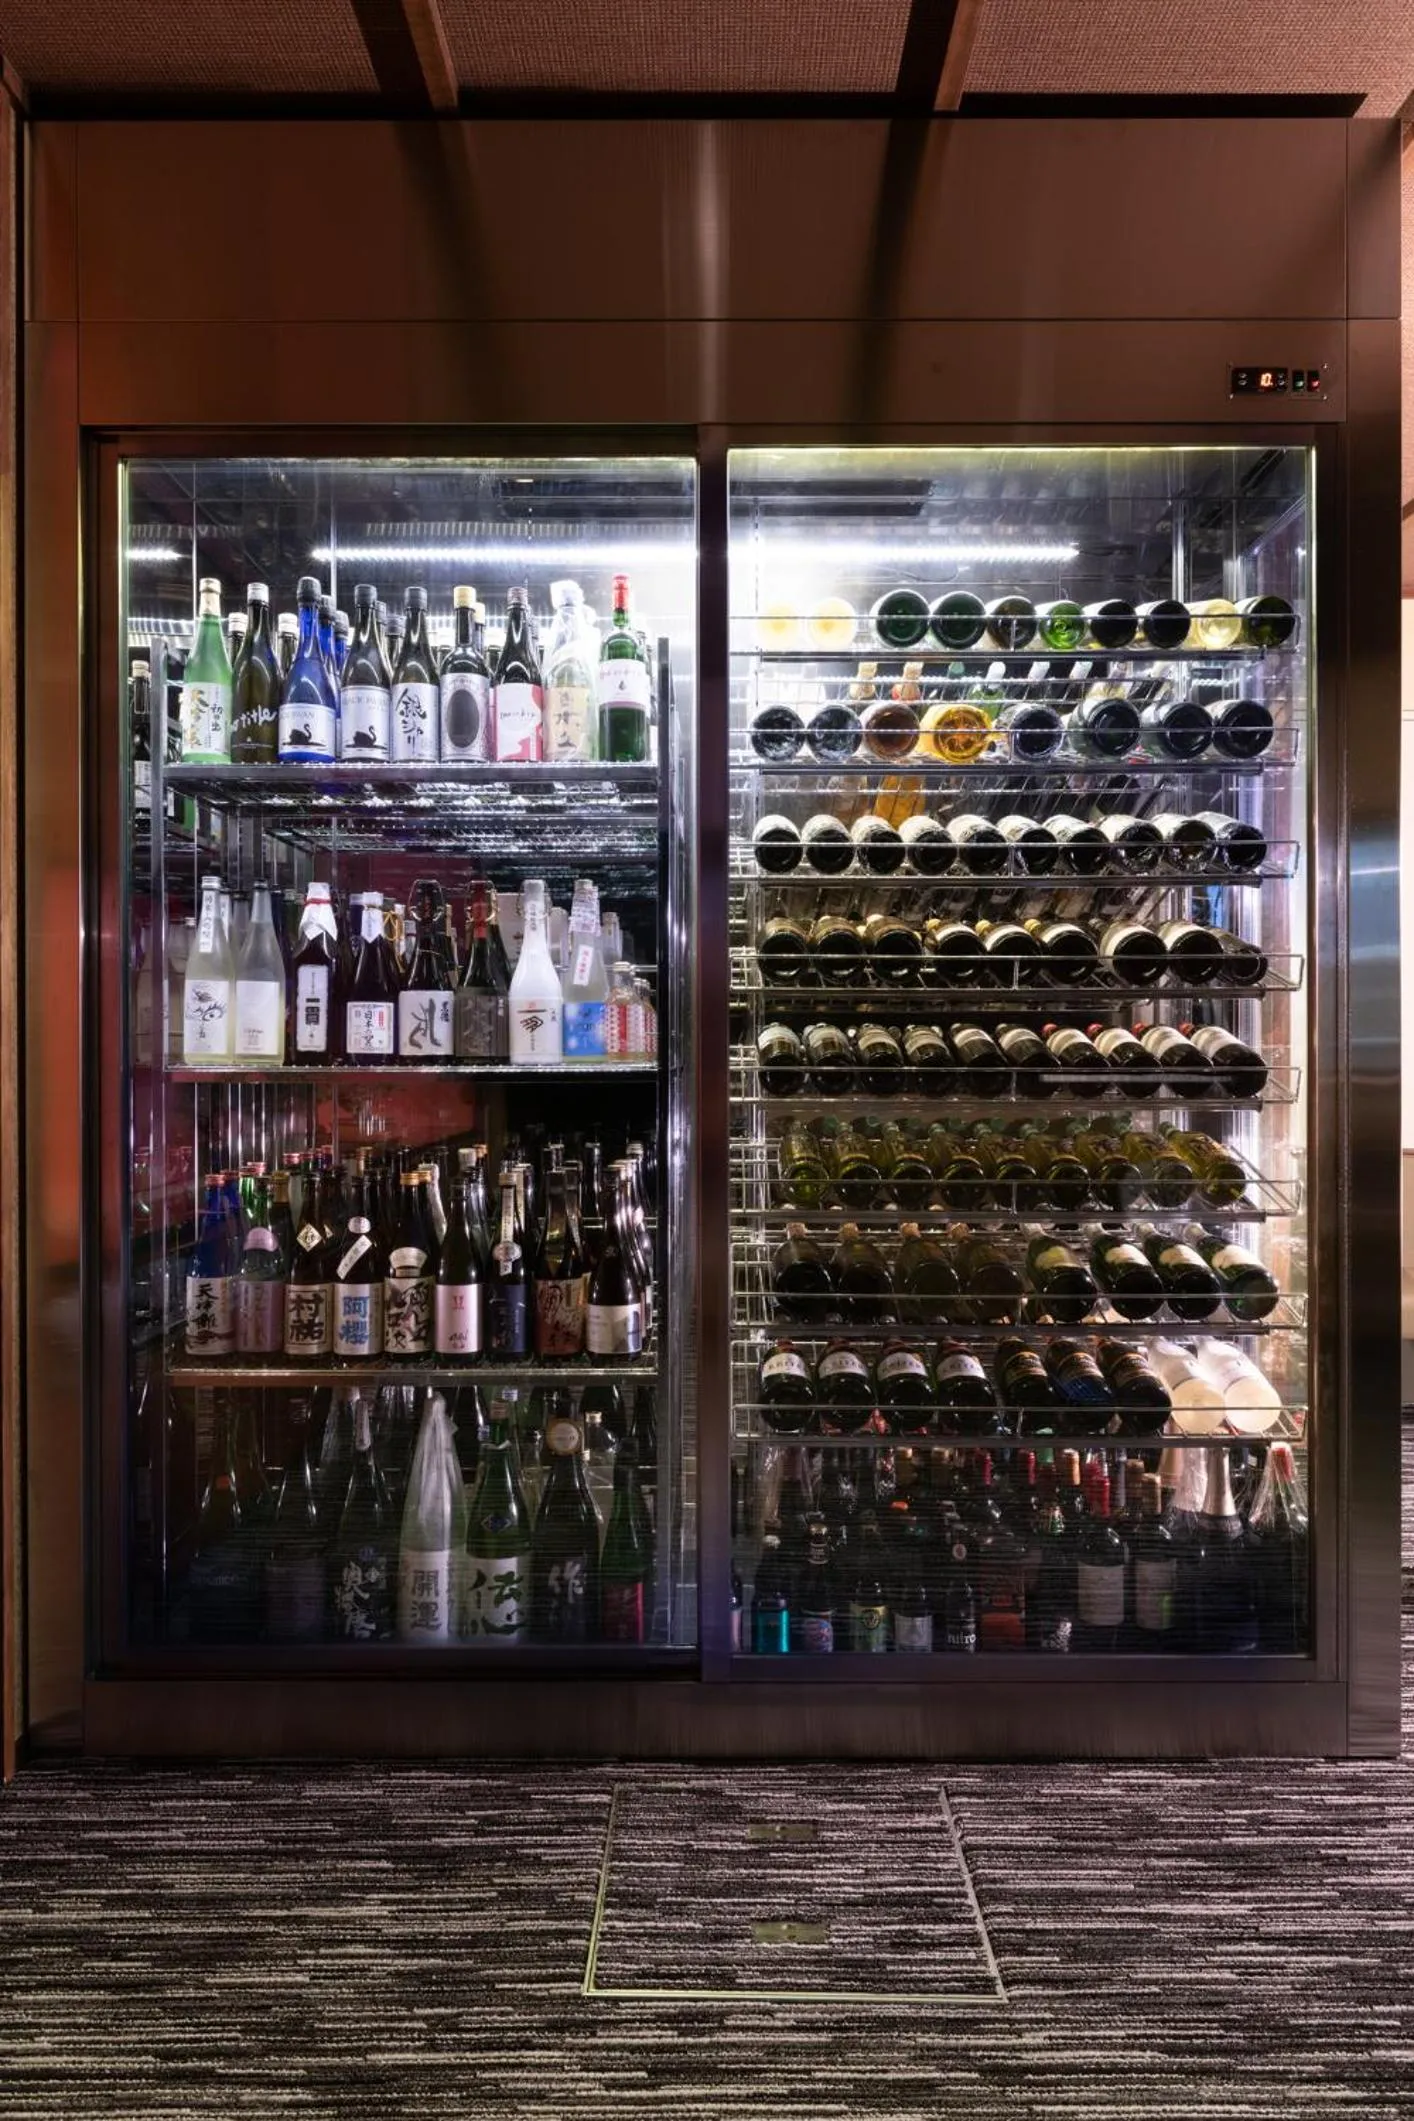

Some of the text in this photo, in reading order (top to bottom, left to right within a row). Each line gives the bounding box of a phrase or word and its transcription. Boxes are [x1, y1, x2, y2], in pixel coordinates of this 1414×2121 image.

[395, 688, 428, 752] 銀シャリ
[410, 1569, 442, 1631] 開運
